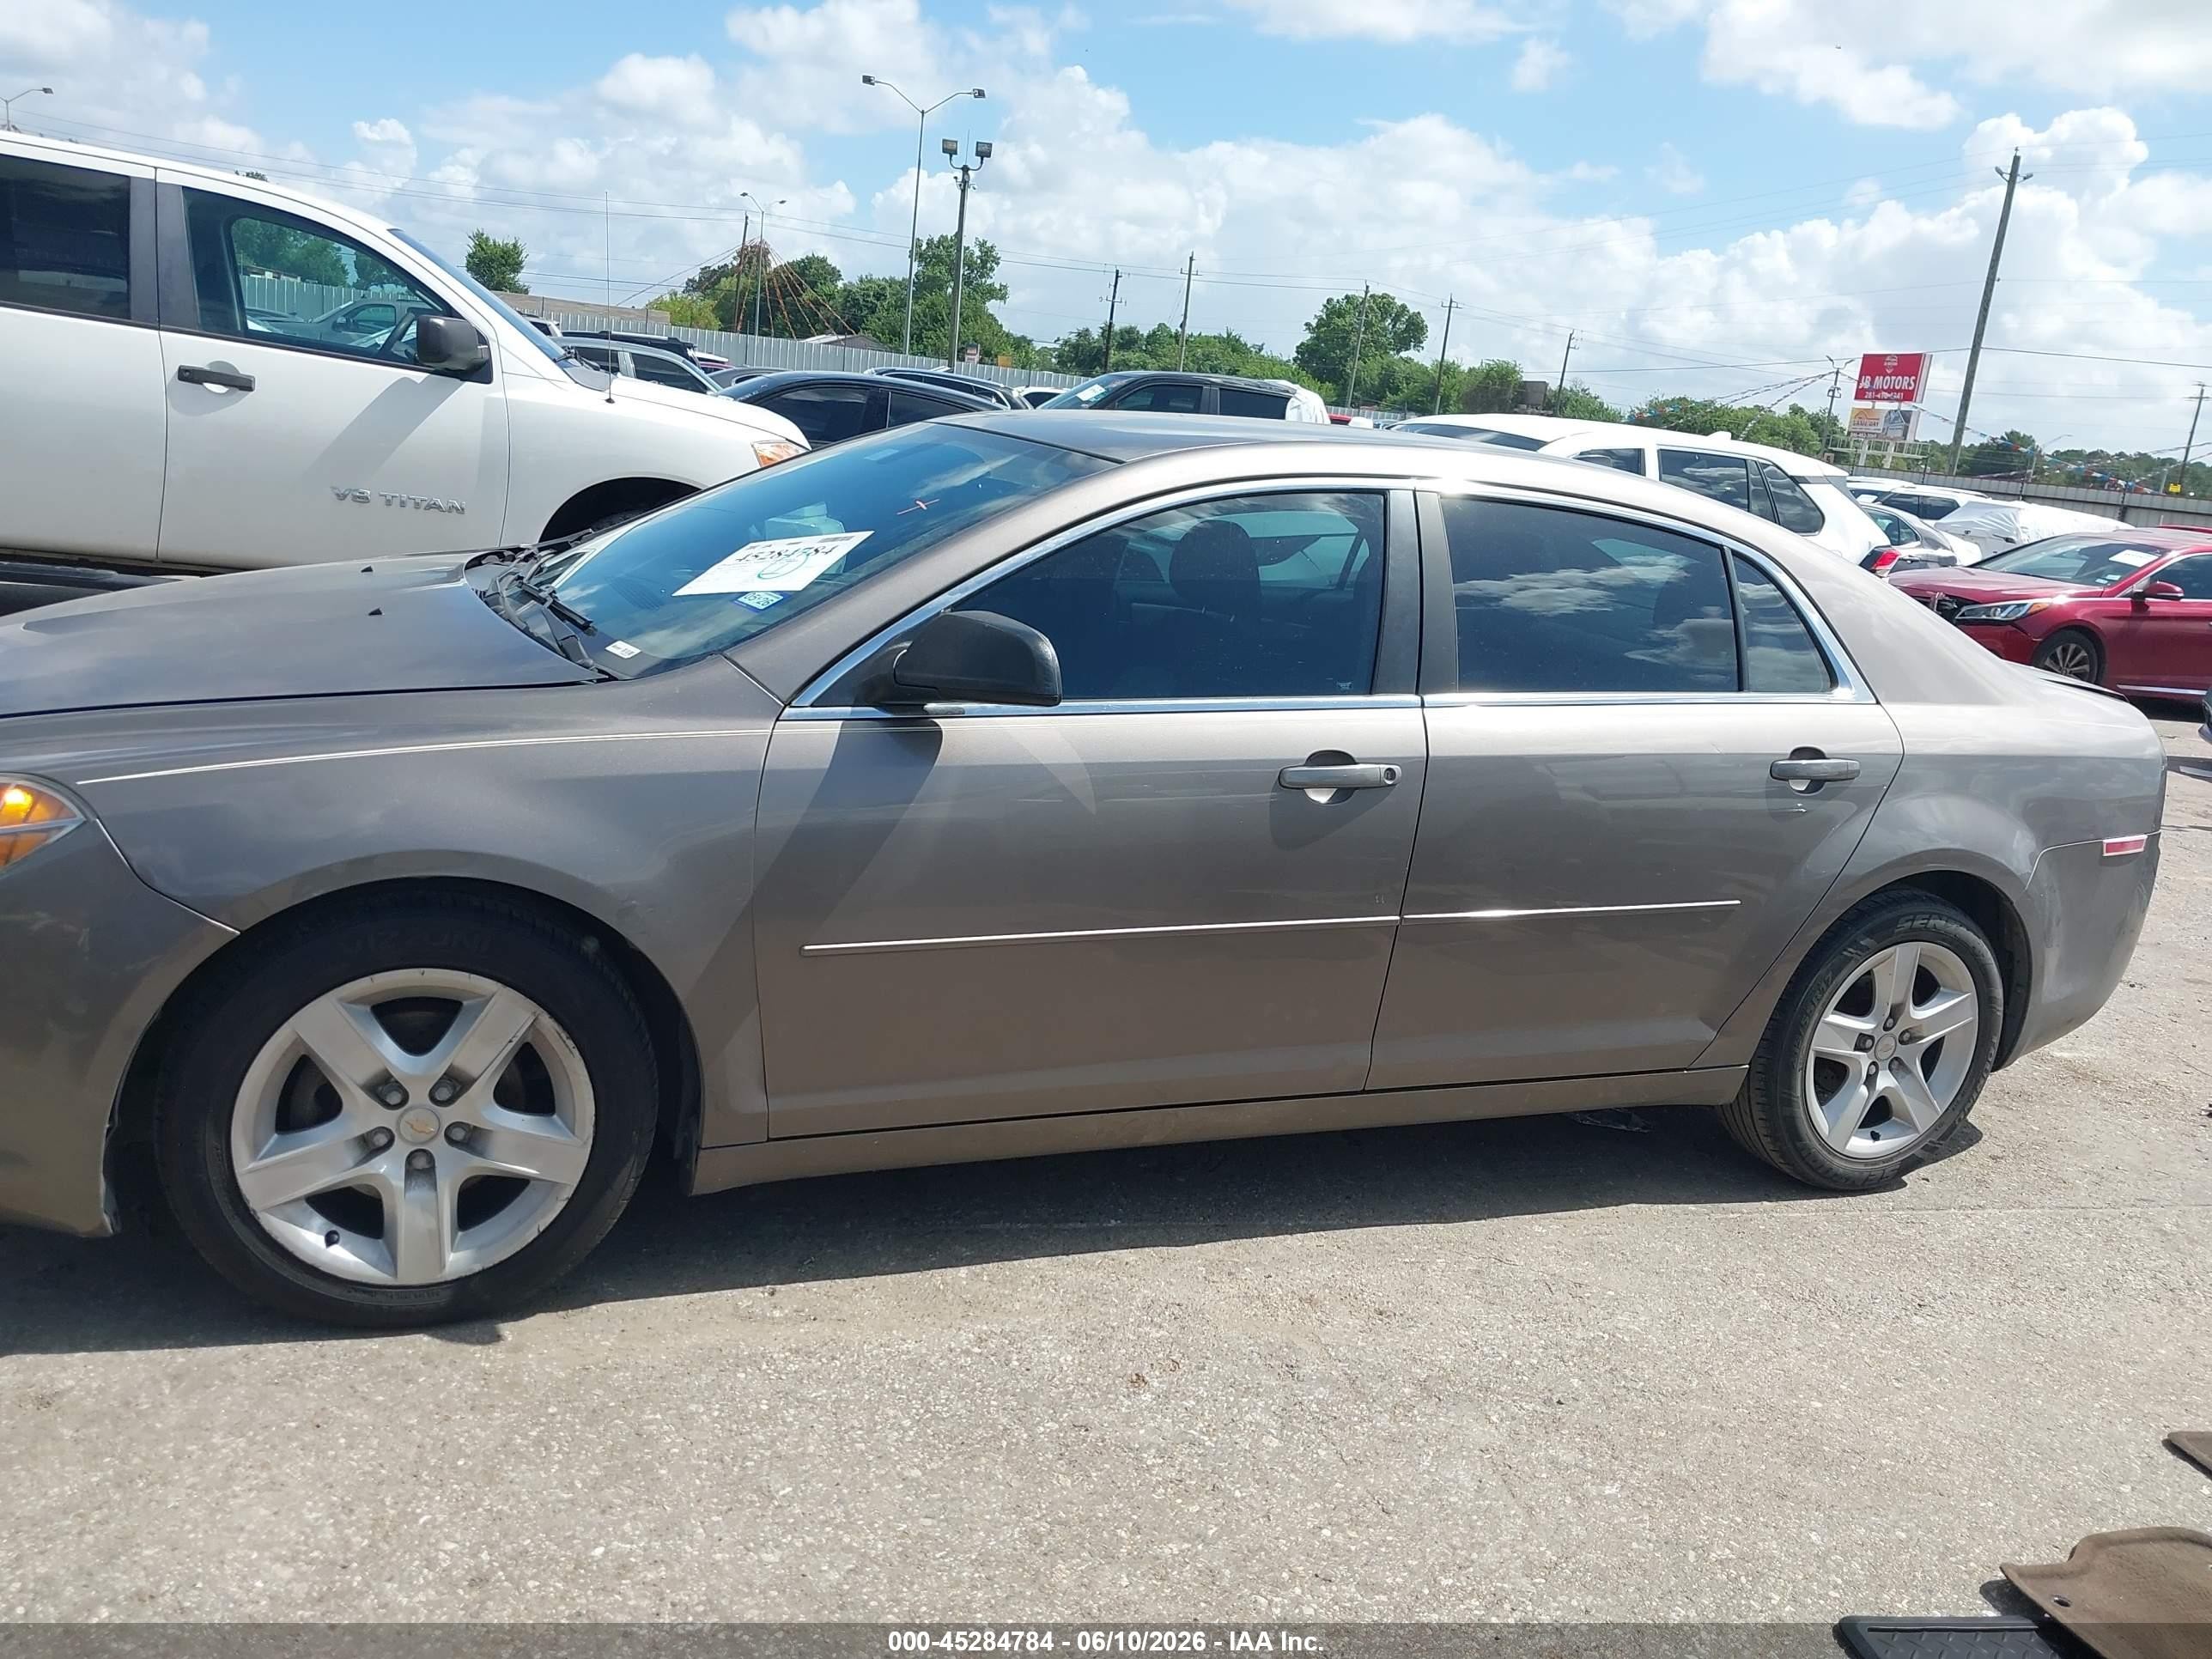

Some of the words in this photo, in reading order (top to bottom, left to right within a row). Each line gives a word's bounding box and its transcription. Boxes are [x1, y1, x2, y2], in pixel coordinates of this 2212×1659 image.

[1859, 375, 1871, 388] JB
[1873, 375, 1916, 390] MOTORS
[331, 487, 371, 503] V8
[379, 492, 466, 514] TITAN
